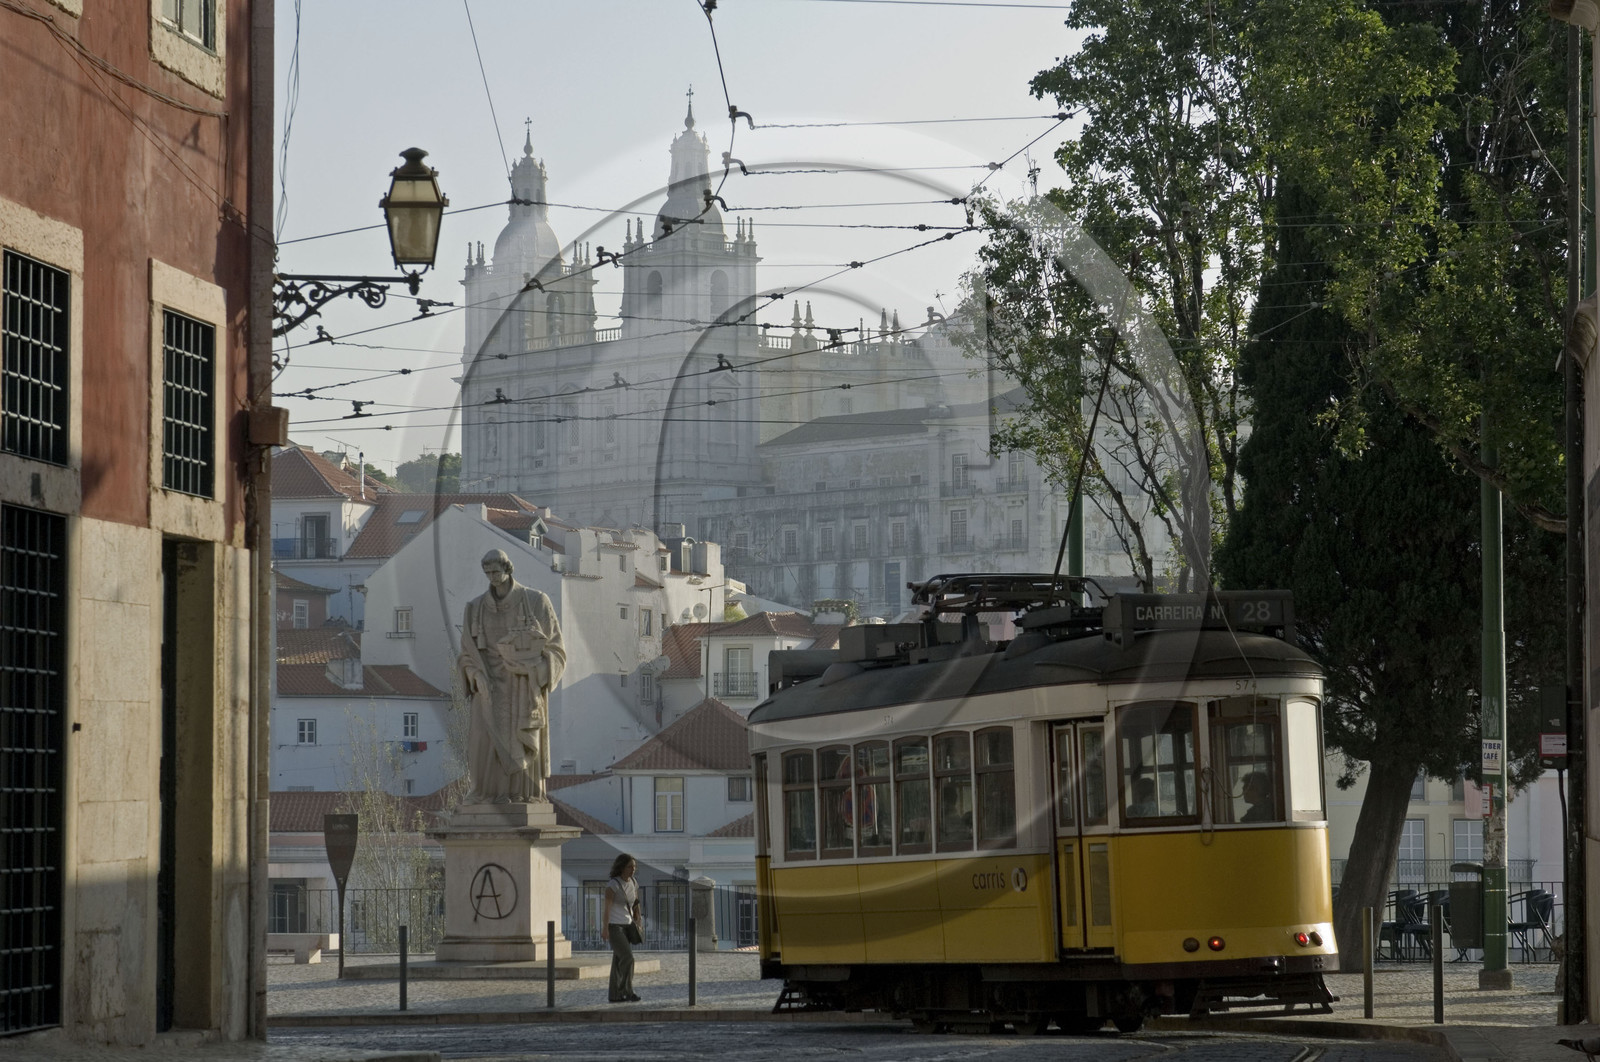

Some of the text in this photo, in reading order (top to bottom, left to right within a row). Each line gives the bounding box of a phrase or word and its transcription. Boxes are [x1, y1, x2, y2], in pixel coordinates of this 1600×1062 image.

[1136, 605, 1202, 621] CARREIRA
[1242, 601, 1271, 622] 28
[972, 864, 1006, 890] carris
